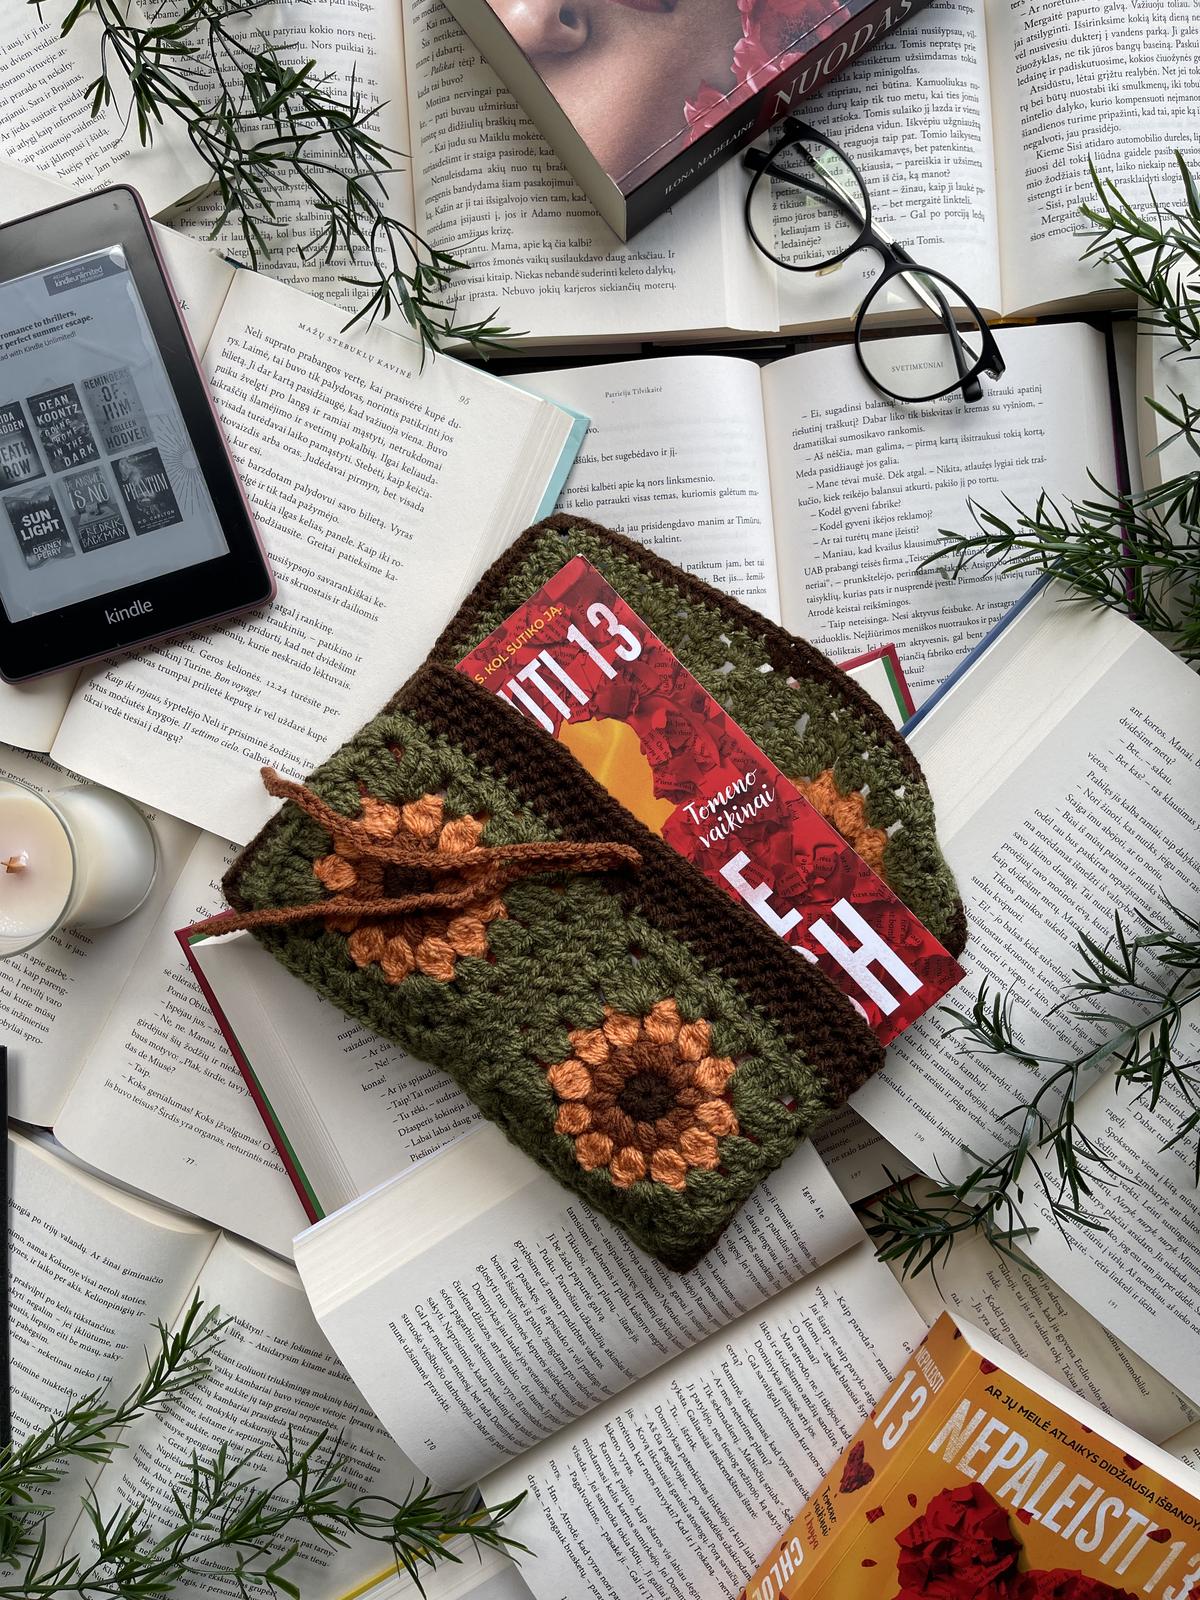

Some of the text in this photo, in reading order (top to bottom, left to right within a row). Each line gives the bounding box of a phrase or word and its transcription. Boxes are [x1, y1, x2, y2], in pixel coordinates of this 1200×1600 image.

[1023, 1, 1128, 31] Mergaitė papurto galvą.
[56, 160, 84, 179] Nuėjęs
[84, 151, 100, 166] prie
[664, 119, 756, 196] ILONA MADELAINE
[468, 282, 677, 302] įprasta. Nebuvo jokių karjeros siekiančių moterų.
[0, 310, 77, 340] romance to thrillers,
[5, 314, 93, 350] perfect summer escape.
[9, 331, 77, 359] with Kindle Unlimited!
[298, 322, 412, 379] MAŽŲ STEBUKLŲ KAVINĖ
[244, 324, 462, 429] Neli suprato prabangos vertę, kai prasivėrė kupė du-
[37, 403, 80, 425] KOONTZ
[38, 394, 69, 412] DEAN
[53, 436, 84, 457] IN THE
[105, 426, 150, 449] HOOVER
[792, 424, 926, 451] dramatiškai sumosikavo rankomis.
[3, 458, 31, 480] ROW
[63, 443, 94, 467] DARK
[795, 456, 900, 480] Meda pasidžiaugė jos galia.
[89, 482, 110, 507] NO
[567, 474, 716, 496] norėsi kalbėti apie ką nors linksmesnio.
[20, 519, 60, 541] LIGHT
[21, 508, 52, 527] SUN
[36, 546, 62, 561] PERRY
[104, 601, 154, 626] kindle
[807, 599, 911, 618] Atrodė keistai reikšmingos.
[484, 654, 510, 675] KOL
[506, 618, 545, 656] SUTIKO
[543, 605, 563, 622] JĄ.
[566, 602, 643, 681] 13
[242, 637, 270, 654] kurie
[271, 650, 312, 673] neskraido
[312, 665, 351, 690] lėktuvais.
[83, 693, 104, 709] tikrai
[104, 704, 123, 718] vedė
[122, 711, 148, 730] tiesiai
[153, 725, 184, 745] dangų?
[1119, 717, 1177, 766] dvidešimt metų?
[1087, 751, 1108, 773] vietos.
[682, 768, 758, 827] Tomeno
[698, 783, 776, 849] vaikinai
[970, 876, 1025, 924] sunku kvėpuoti.
[124, 1042, 177, 1074] das de Miusė?
[361, 1074, 387, 1092] konas!
[127, 1075, 266, 1149] Koks genialumas! Koks įžvalgumas!
[397, 1116, 434, 1137] Džasperis
[30, 1215, 164, 1284] po trijų valandų. Ar žinai giminaičio
[388, 1321, 452, 1413] munė užsimanė pravirkti.
[914, 1345, 946, 1395] NEPALEISTI
[873, 1368, 929, 1451] 13
[423, 1437, 437, 1452] 170
[680, 1426, 697, 1453] išrink.
[984, 1384, 1200, 1533] AR JŲ MEILĖ ATLAIKYS DIDŽIAUSIĄ IŠBANDY
[927, 1398, 1160, 1576] NEPALEISTI
